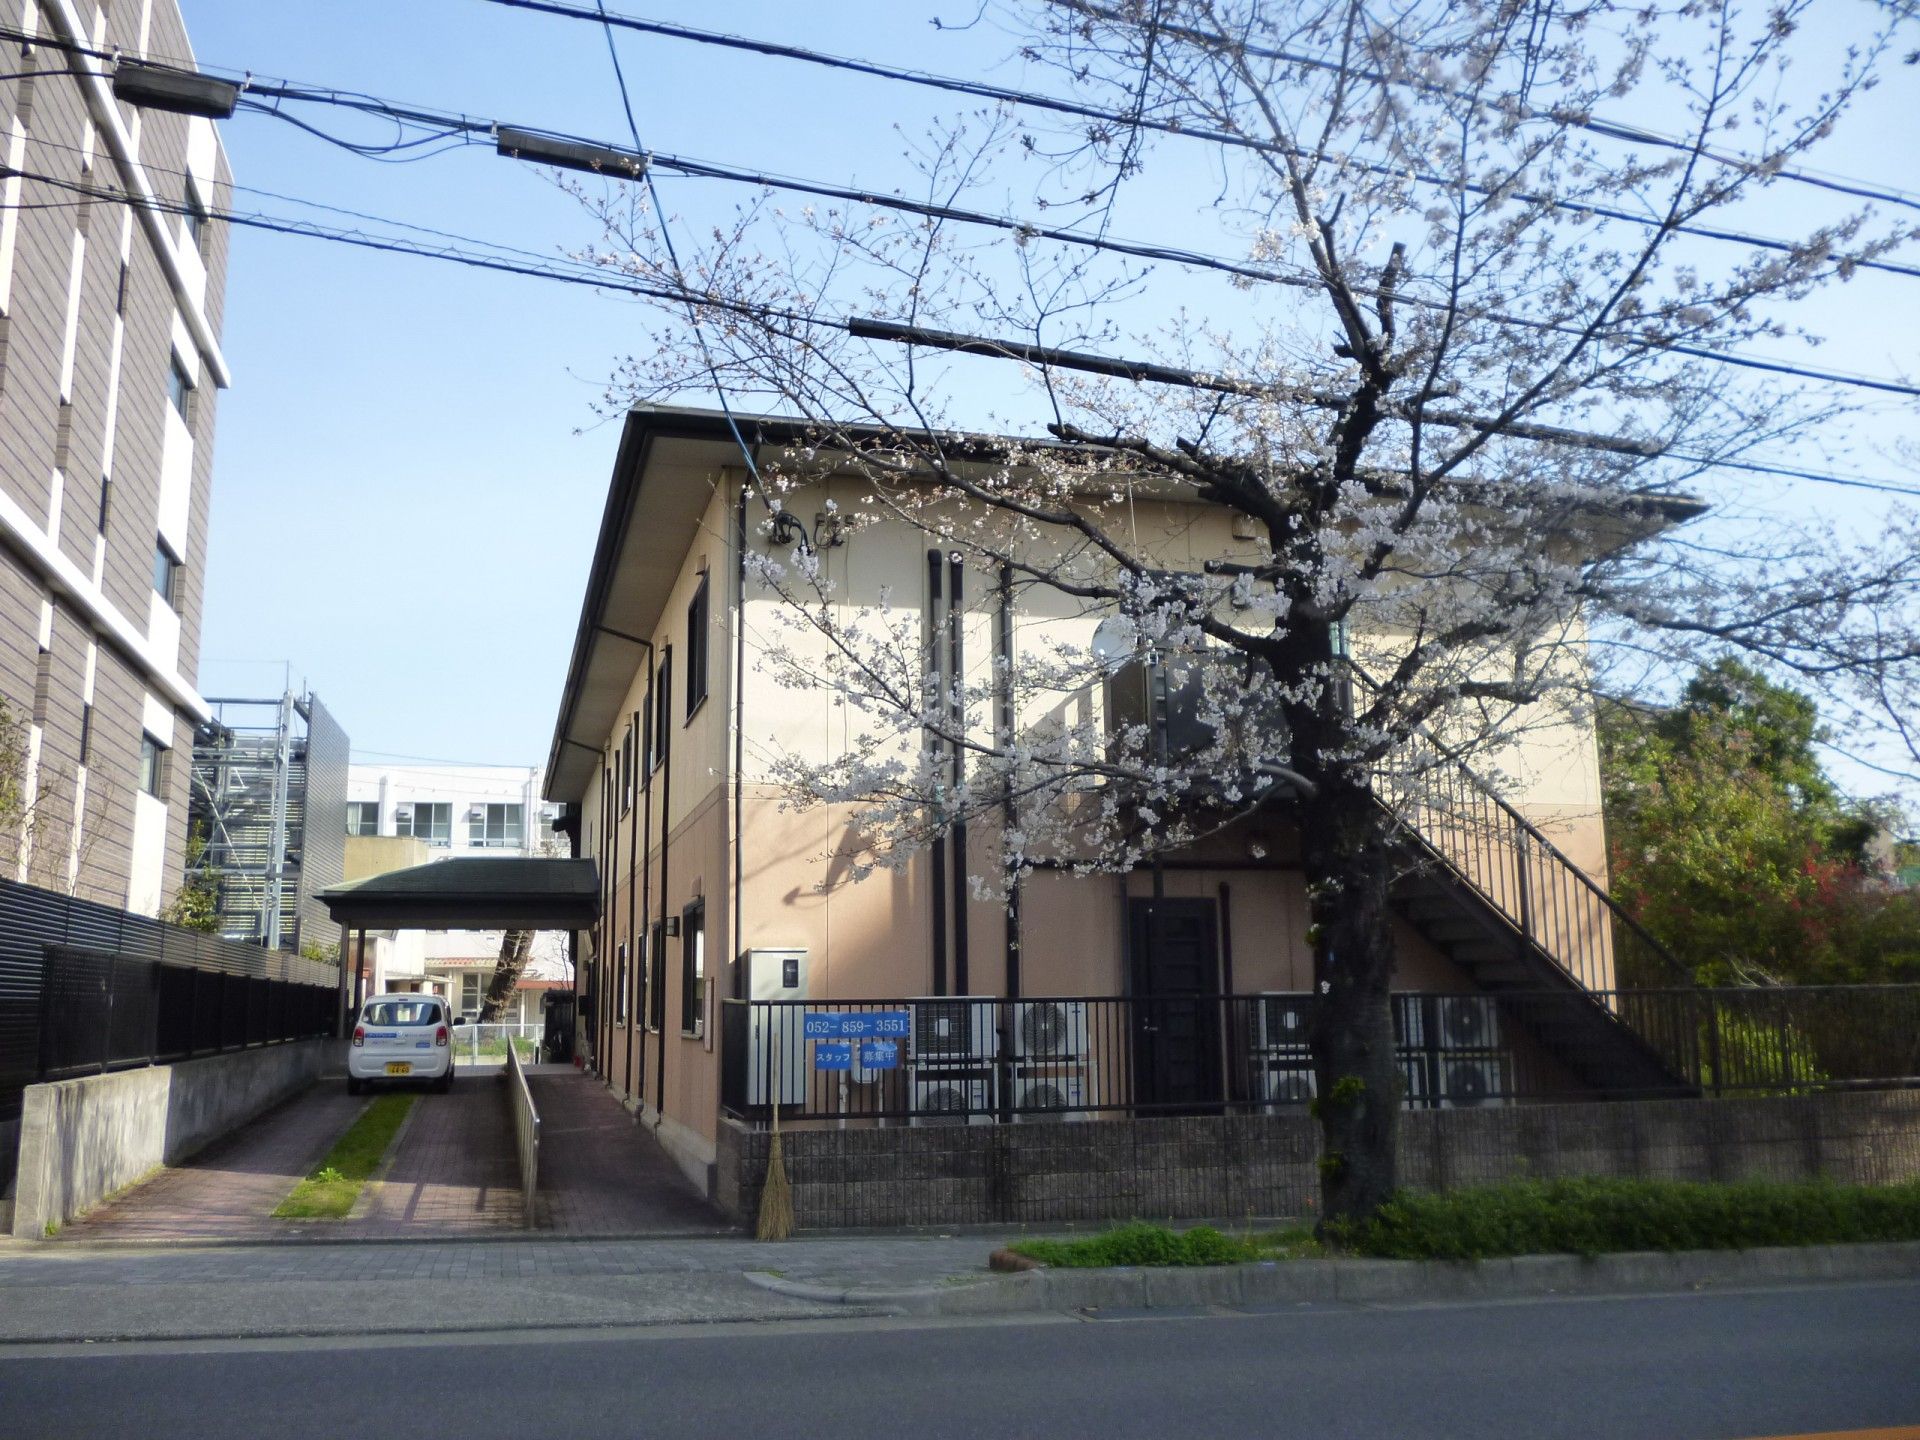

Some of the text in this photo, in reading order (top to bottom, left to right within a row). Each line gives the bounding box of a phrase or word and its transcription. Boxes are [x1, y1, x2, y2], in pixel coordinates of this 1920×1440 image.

[816, 1050, 895, 1062] スタッフ 募集中
